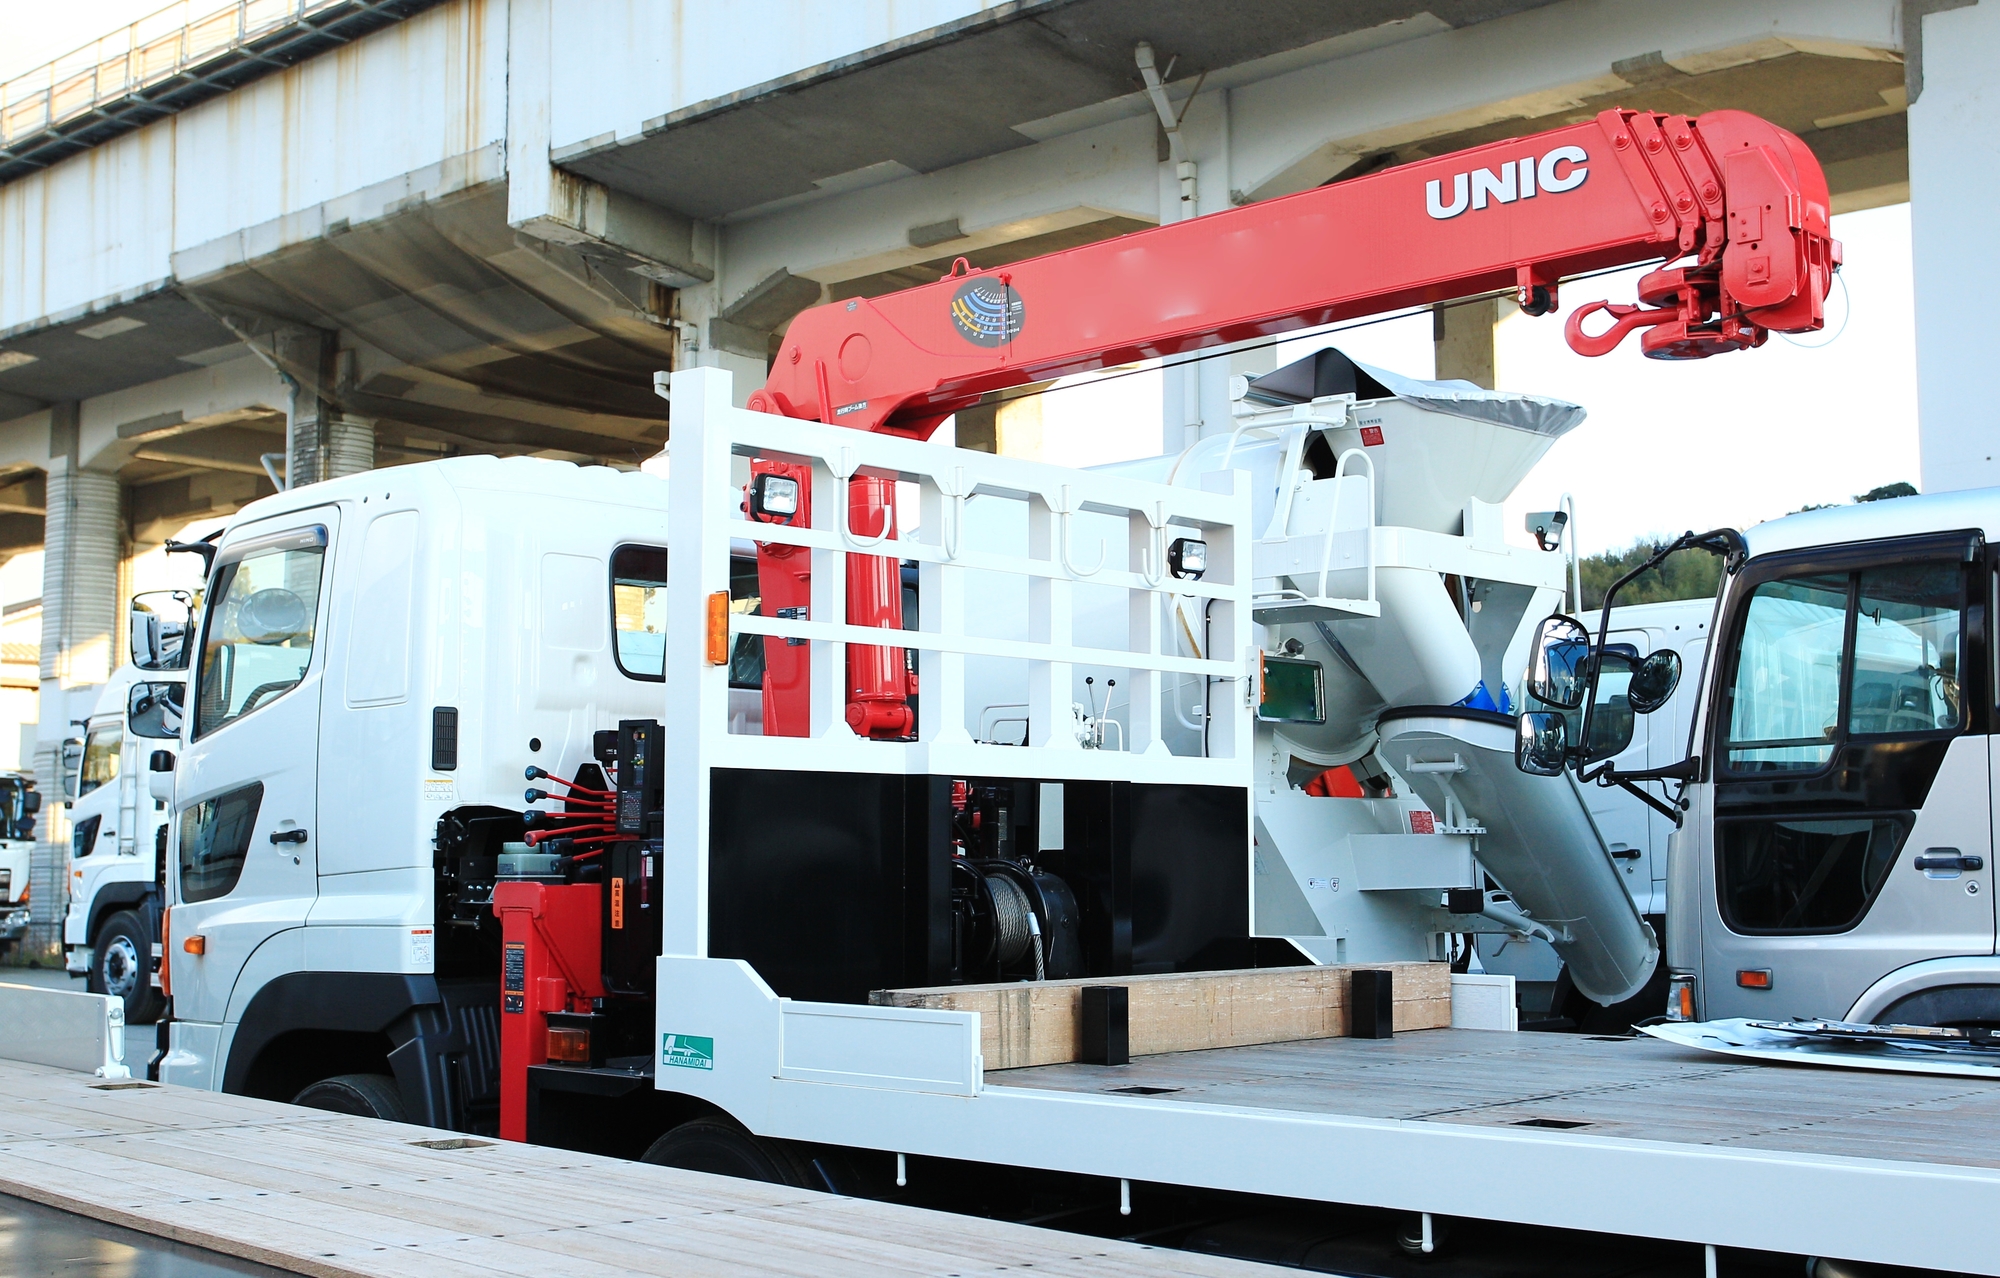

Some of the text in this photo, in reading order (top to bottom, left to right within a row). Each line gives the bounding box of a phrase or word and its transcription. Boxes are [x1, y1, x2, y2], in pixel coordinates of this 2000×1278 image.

[1426, 145, 1589, 220] UNIC
[300, 536, 314, 544] HINO
[669, 1055, 707, 1067] HANAMIDAI
